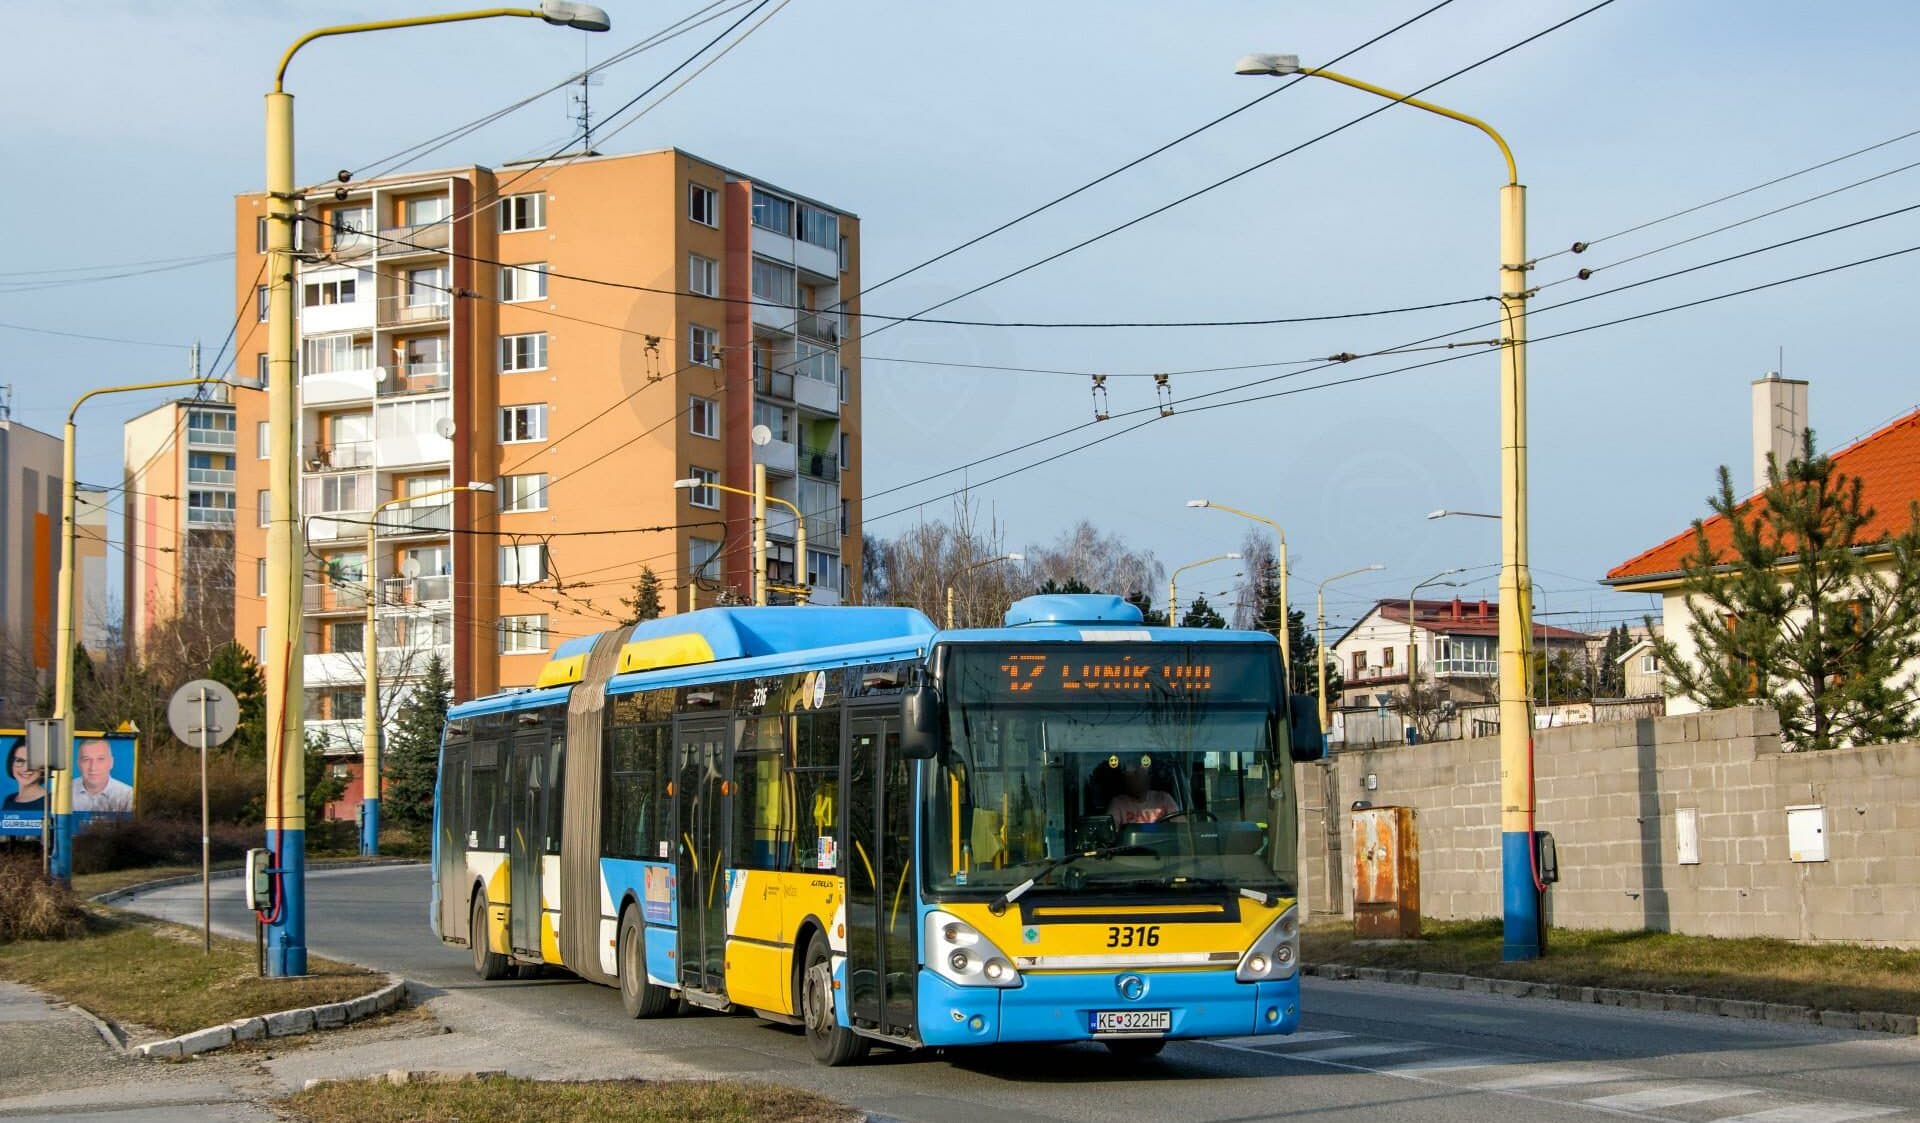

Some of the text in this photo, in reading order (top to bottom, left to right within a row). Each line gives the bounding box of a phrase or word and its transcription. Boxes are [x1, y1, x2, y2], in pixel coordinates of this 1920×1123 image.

[1001, 655, 1046, 690] 17
[1106, 926, 1160, 948] 3316
[1100, 1013, 1167, 1028] KE 322HF
